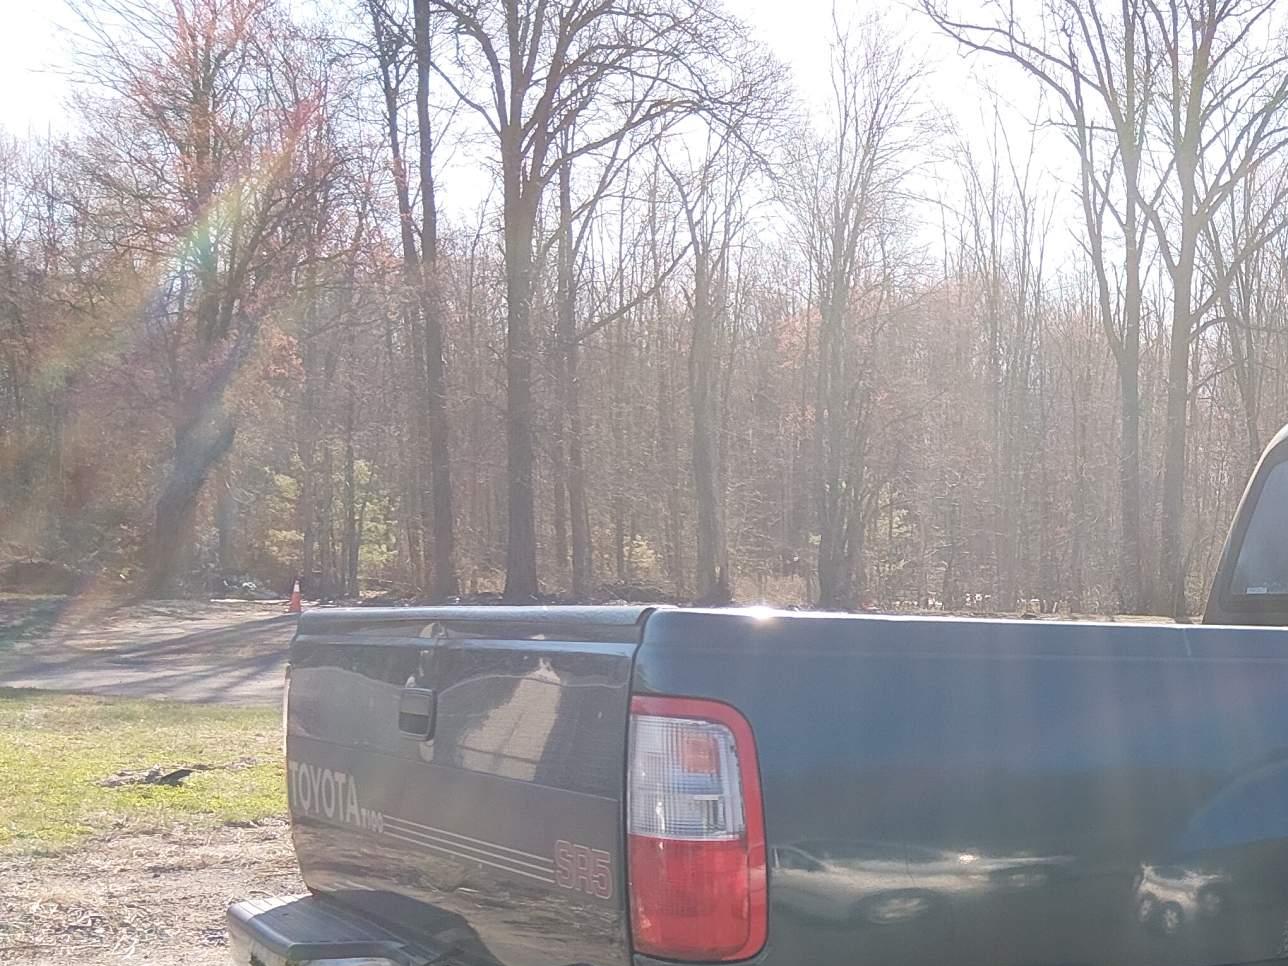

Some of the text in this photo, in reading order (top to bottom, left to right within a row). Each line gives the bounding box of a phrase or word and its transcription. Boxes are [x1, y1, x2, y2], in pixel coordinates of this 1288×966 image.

[288, 760, 384, 833] TOYOTA T100
[553, 838, 615, 901] SR5
